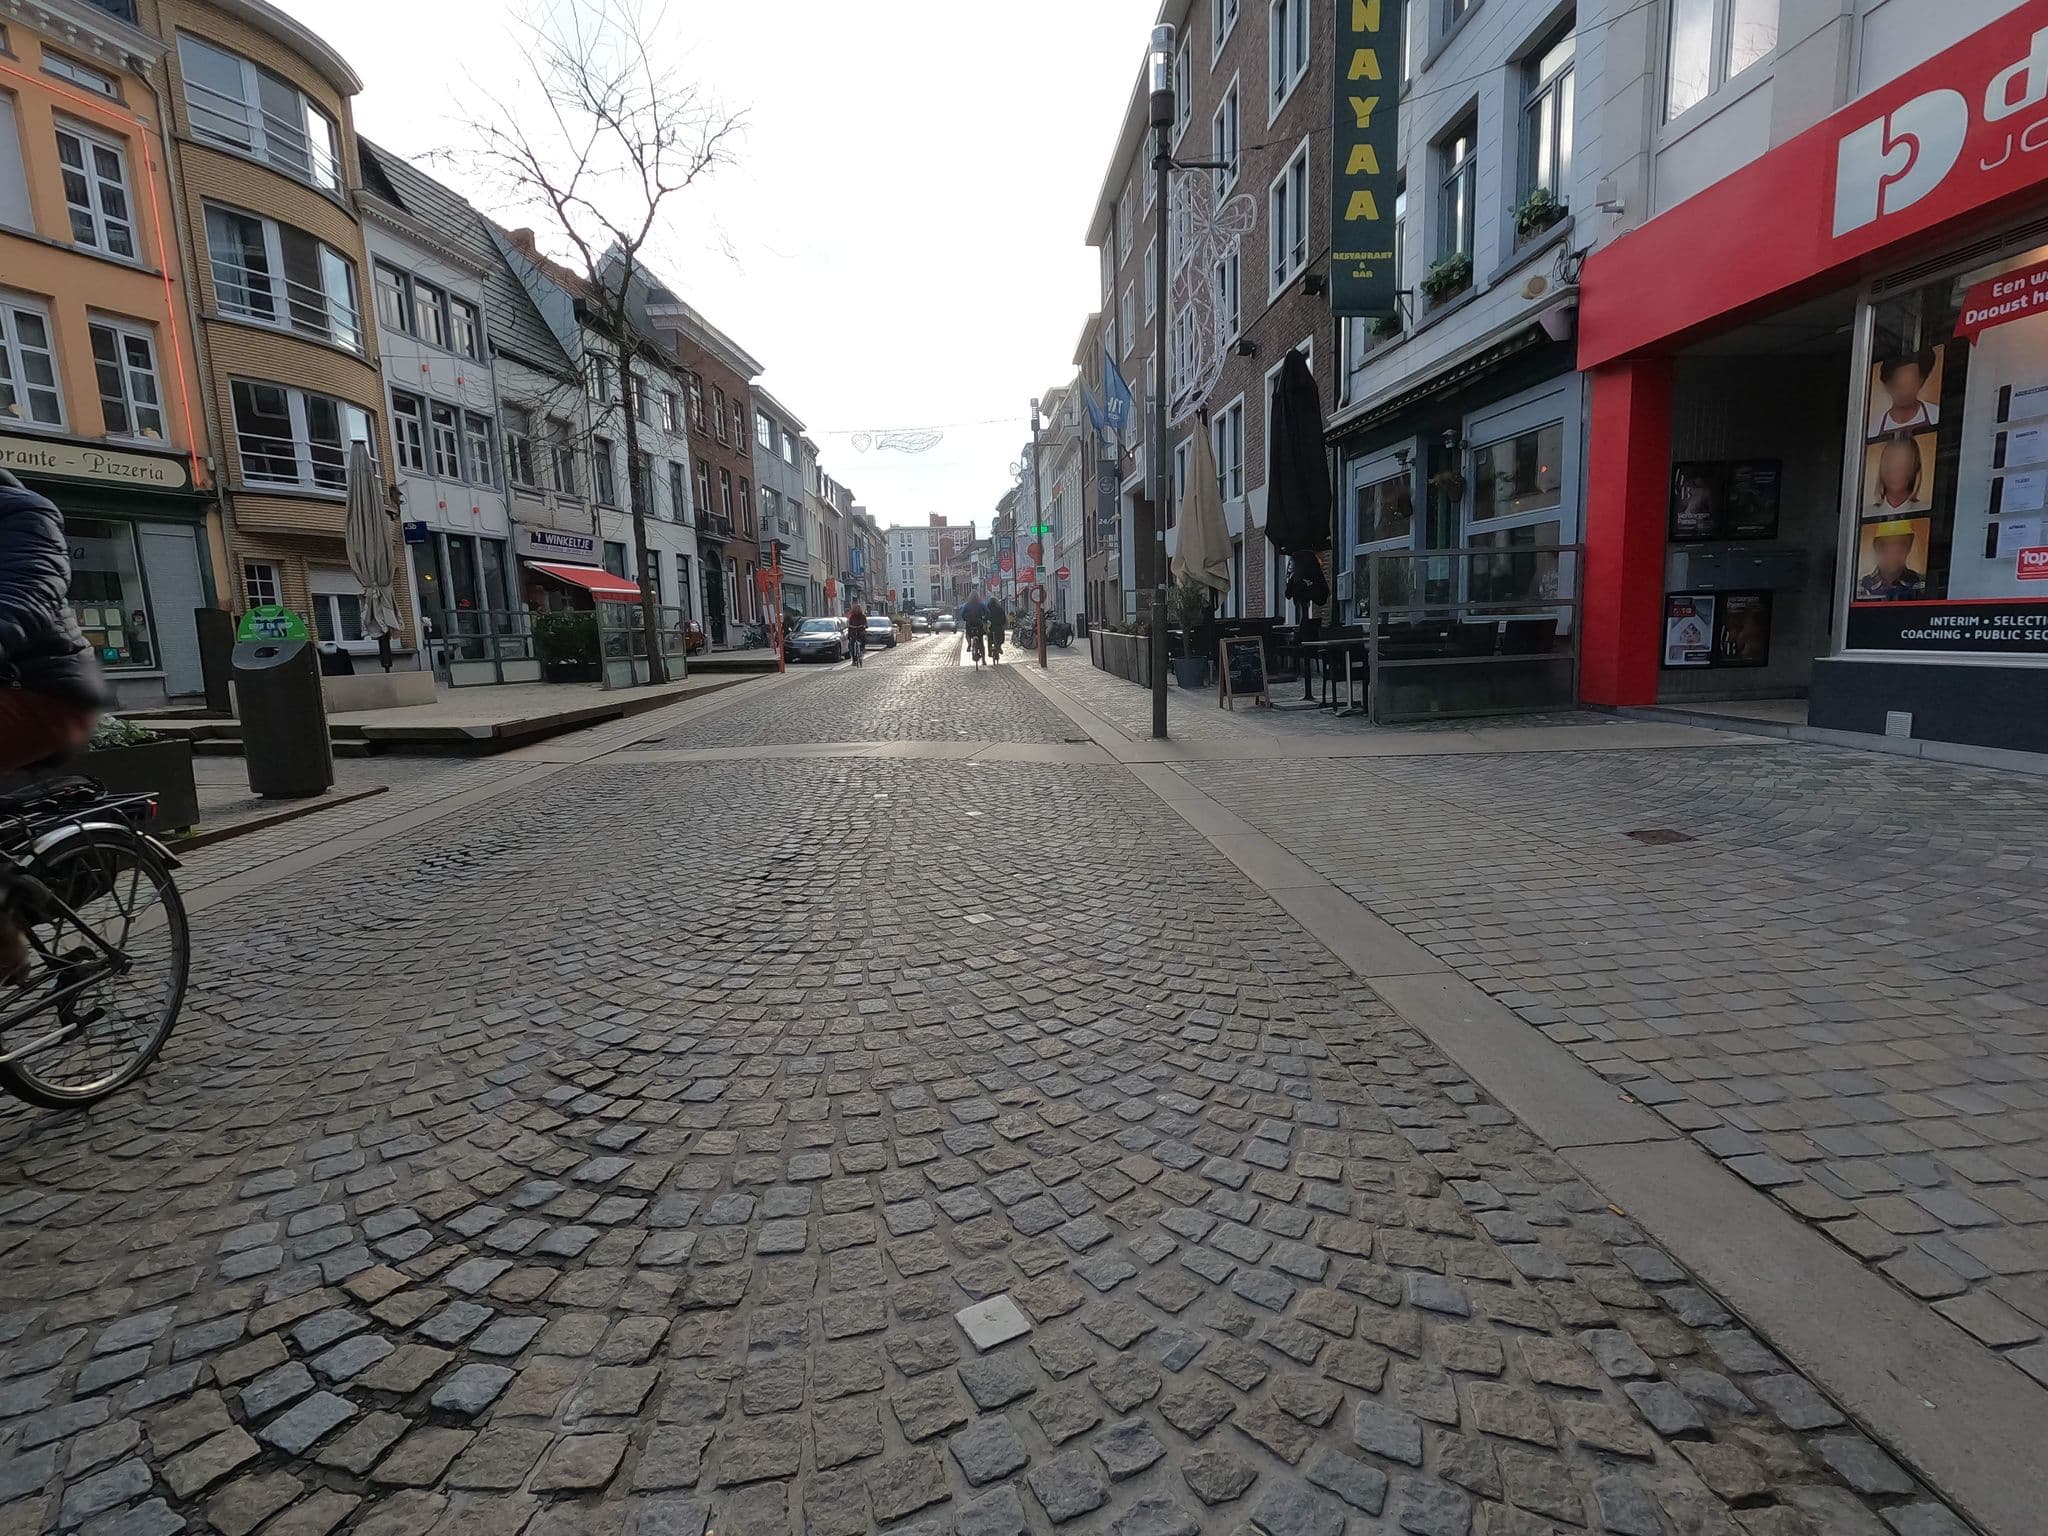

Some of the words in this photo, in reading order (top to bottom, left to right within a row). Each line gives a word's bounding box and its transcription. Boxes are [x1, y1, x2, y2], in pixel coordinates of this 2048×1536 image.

[1344, 0, 1382, 221] NAYAA
[1332, 251, 1393, 260] RESTAURANT
[1352, 270, 1373, 278] BAR
[1992, 278, 2026, 298] Een
[1965, 295, 2029, 325] Daoust
[83, 452, 164, 481] Pizzeria
[544, 533, 590, 549] WINKELTJE
[1930, 616, 1979, 626] INTERIM
[1993, 615, 2048, 626] SELECTI
[1901, 629, 1961, 640] COACHING
[1974, 629, 2021, 640] PUBLIC
